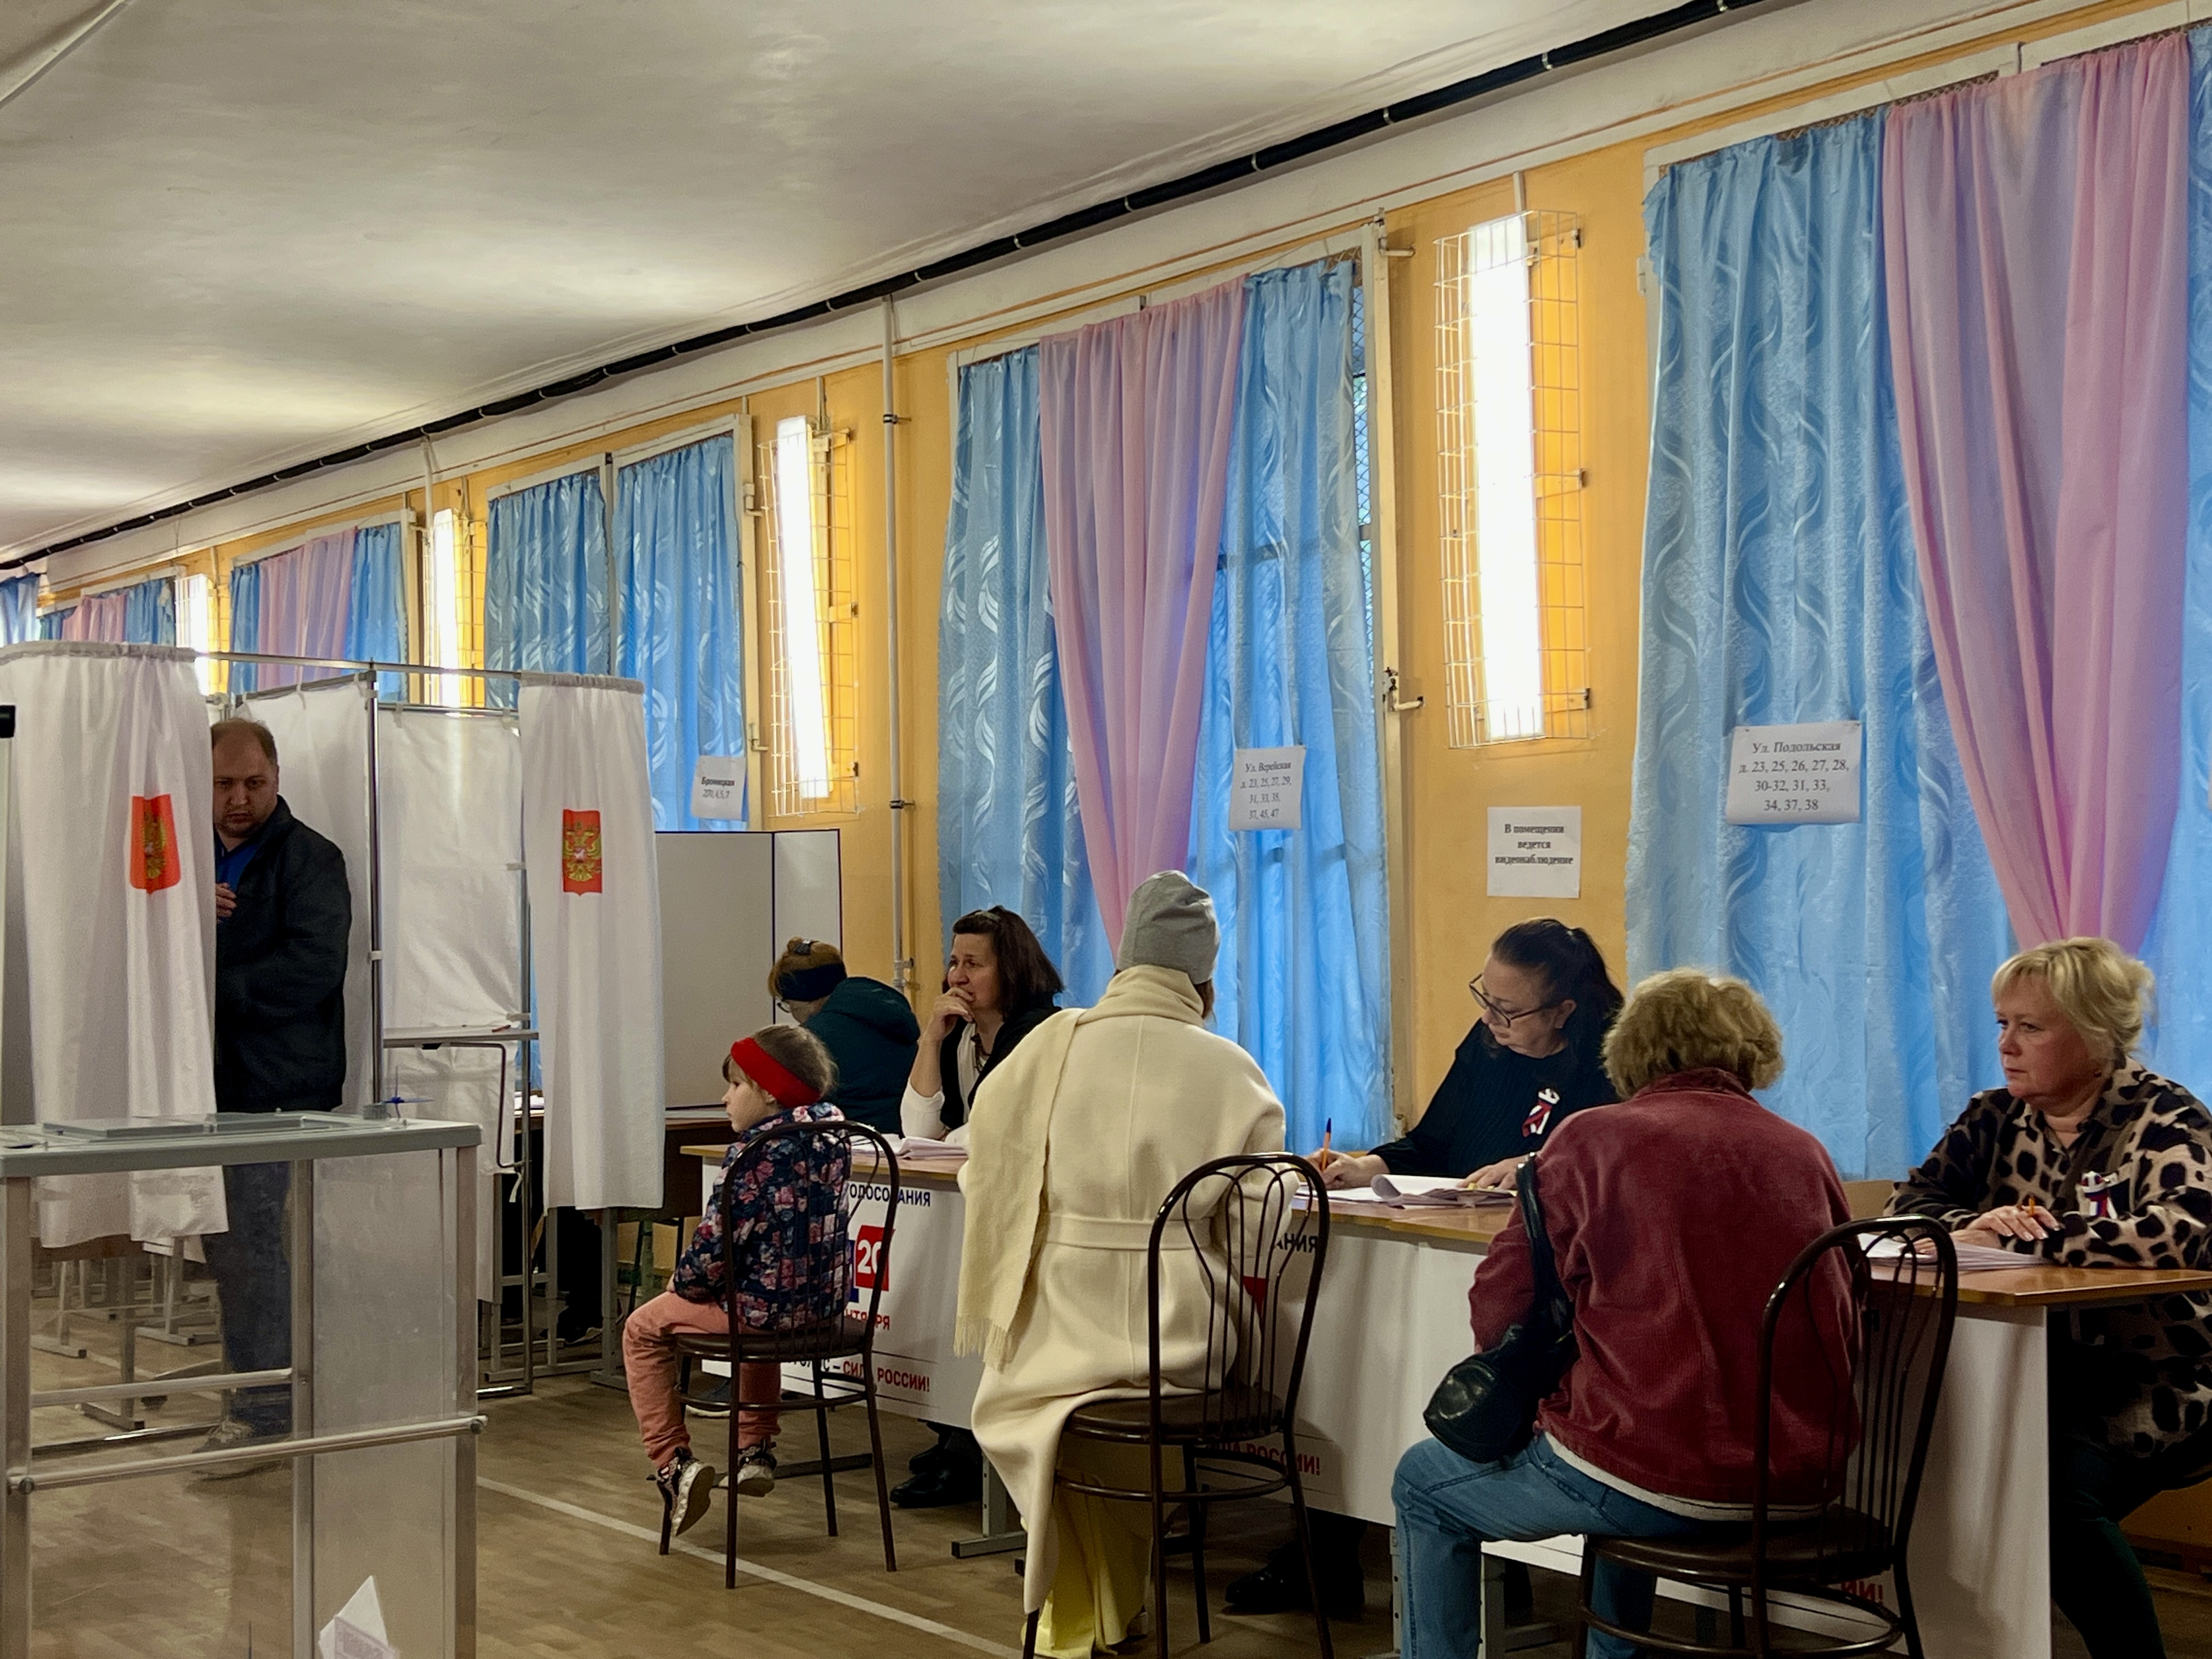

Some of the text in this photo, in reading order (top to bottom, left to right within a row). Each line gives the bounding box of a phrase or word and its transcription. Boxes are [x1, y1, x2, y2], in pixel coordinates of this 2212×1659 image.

[1774, 741, 1841, 753] Подольская
[1752, 761, 1769, 773] 23,
[1771, 760, 1788, 773] 25,
[1791, 760, 1808, 772] 26,
[1832, 759, 1849, 772] 28,
[1813, 779, 1830, 793] 33,
[1764, 799, 1819, 811] 34, 37, 38
[1504, 823, 1565, 835] В помещении
[1517, 842, 1551, 850] ведется
[877, 1367, 931, 1393] РОССИИ!
